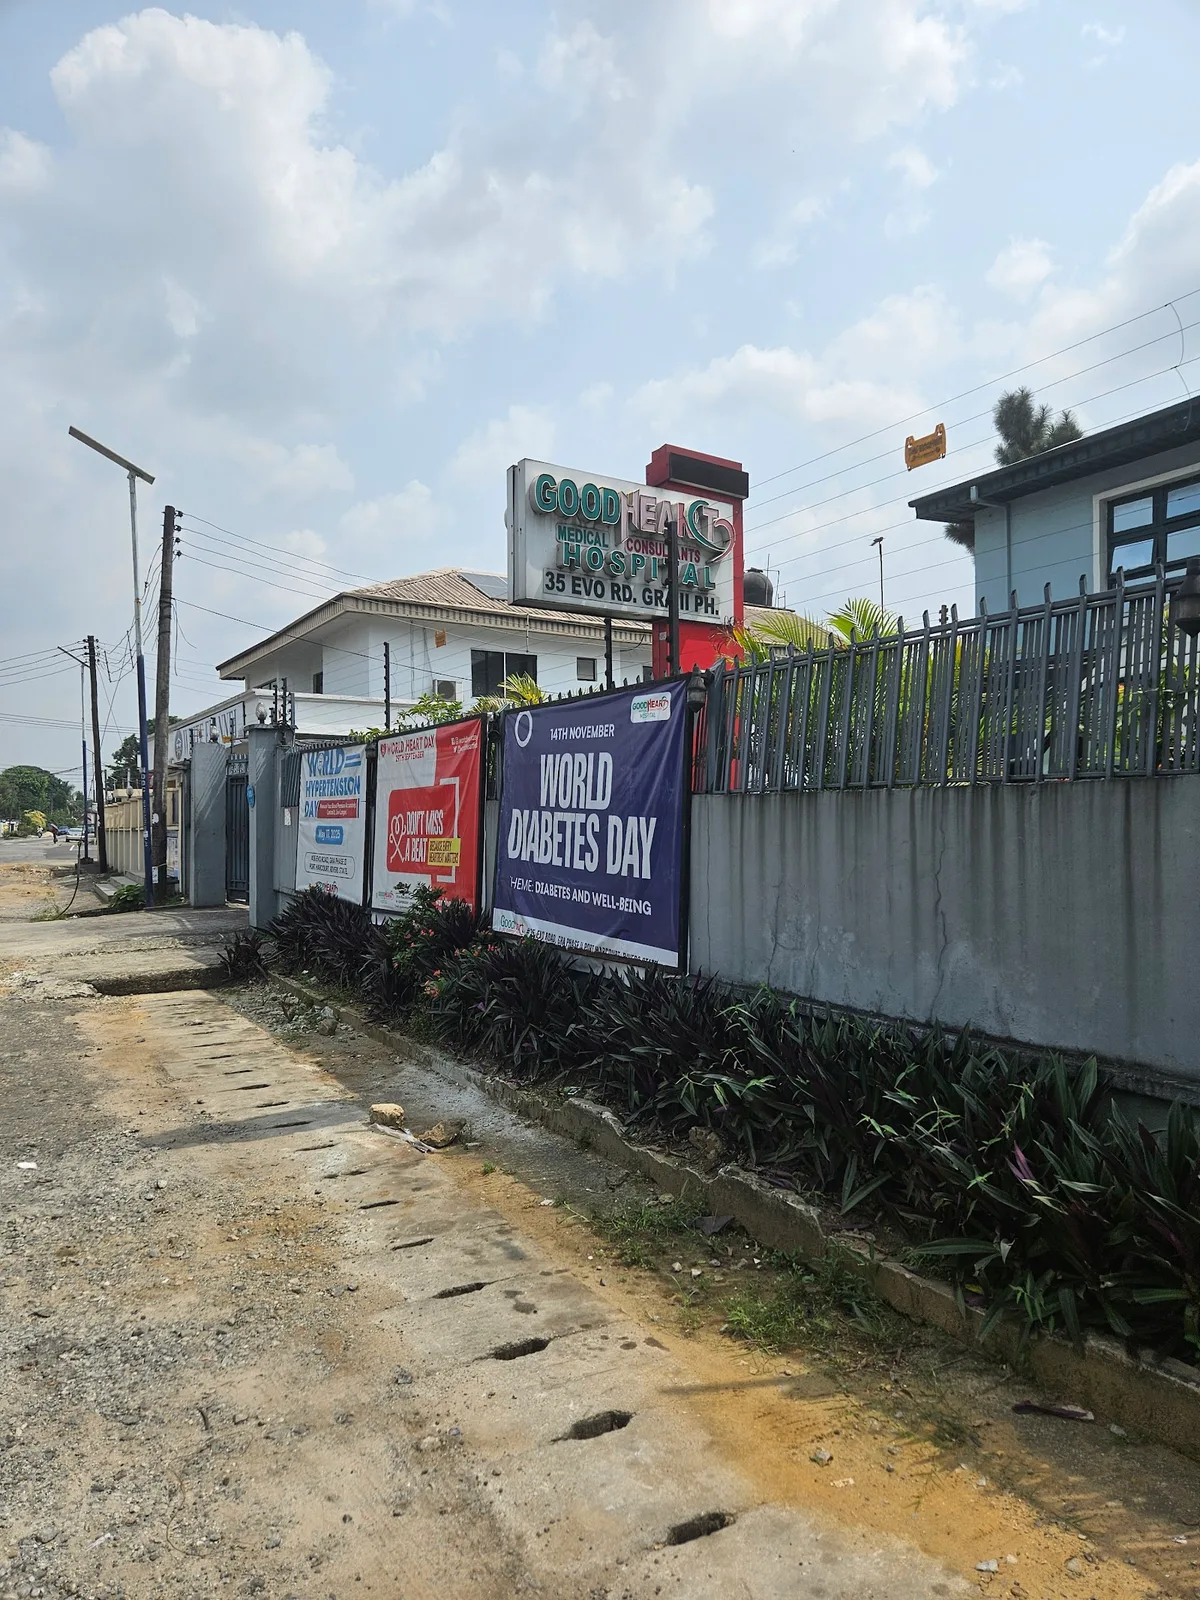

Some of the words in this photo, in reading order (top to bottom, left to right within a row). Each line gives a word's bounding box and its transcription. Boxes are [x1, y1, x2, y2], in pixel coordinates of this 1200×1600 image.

[557, 525, 609, 548] MEDICAL
[626, 537, 701, 564] CONSULNTS
[563, 542, 715, 590] HOSPIAL
[545, 571, 566, 592] 35
[572, 576, 605, 598] EVO
[611, 582, 637, 603] RD.
[680, 592, 690, 610] II
[695, 595, 719, 615] PH.
[387, 740, 404, 755] WORLD
[405, 737, 423, 752] HEART
[424, 735, 435, 748] DAY
[550, 727, 568, 740] 14TH
[569, 724, 615, 739] NOVEMBER
[305, 776, 360, 797] HYPERTENSION
[540, 752, 613, 810] WORLD
[304, 800, 319, 818] DAY
[406, 810, 425, 835] DON'T
[426, 809, 444, 835] MISS
[405, 838, 410, 862] A
[411, 838, 428, 863] BEAT
[507, 808, 600, 873] DIABETES
[606, 815, 657, 879] DAY
[535, 881, 571, 899] DIABETES
[572, 888, 590, 903] AND
[592, 892, 652, 915] WELL-BEING
